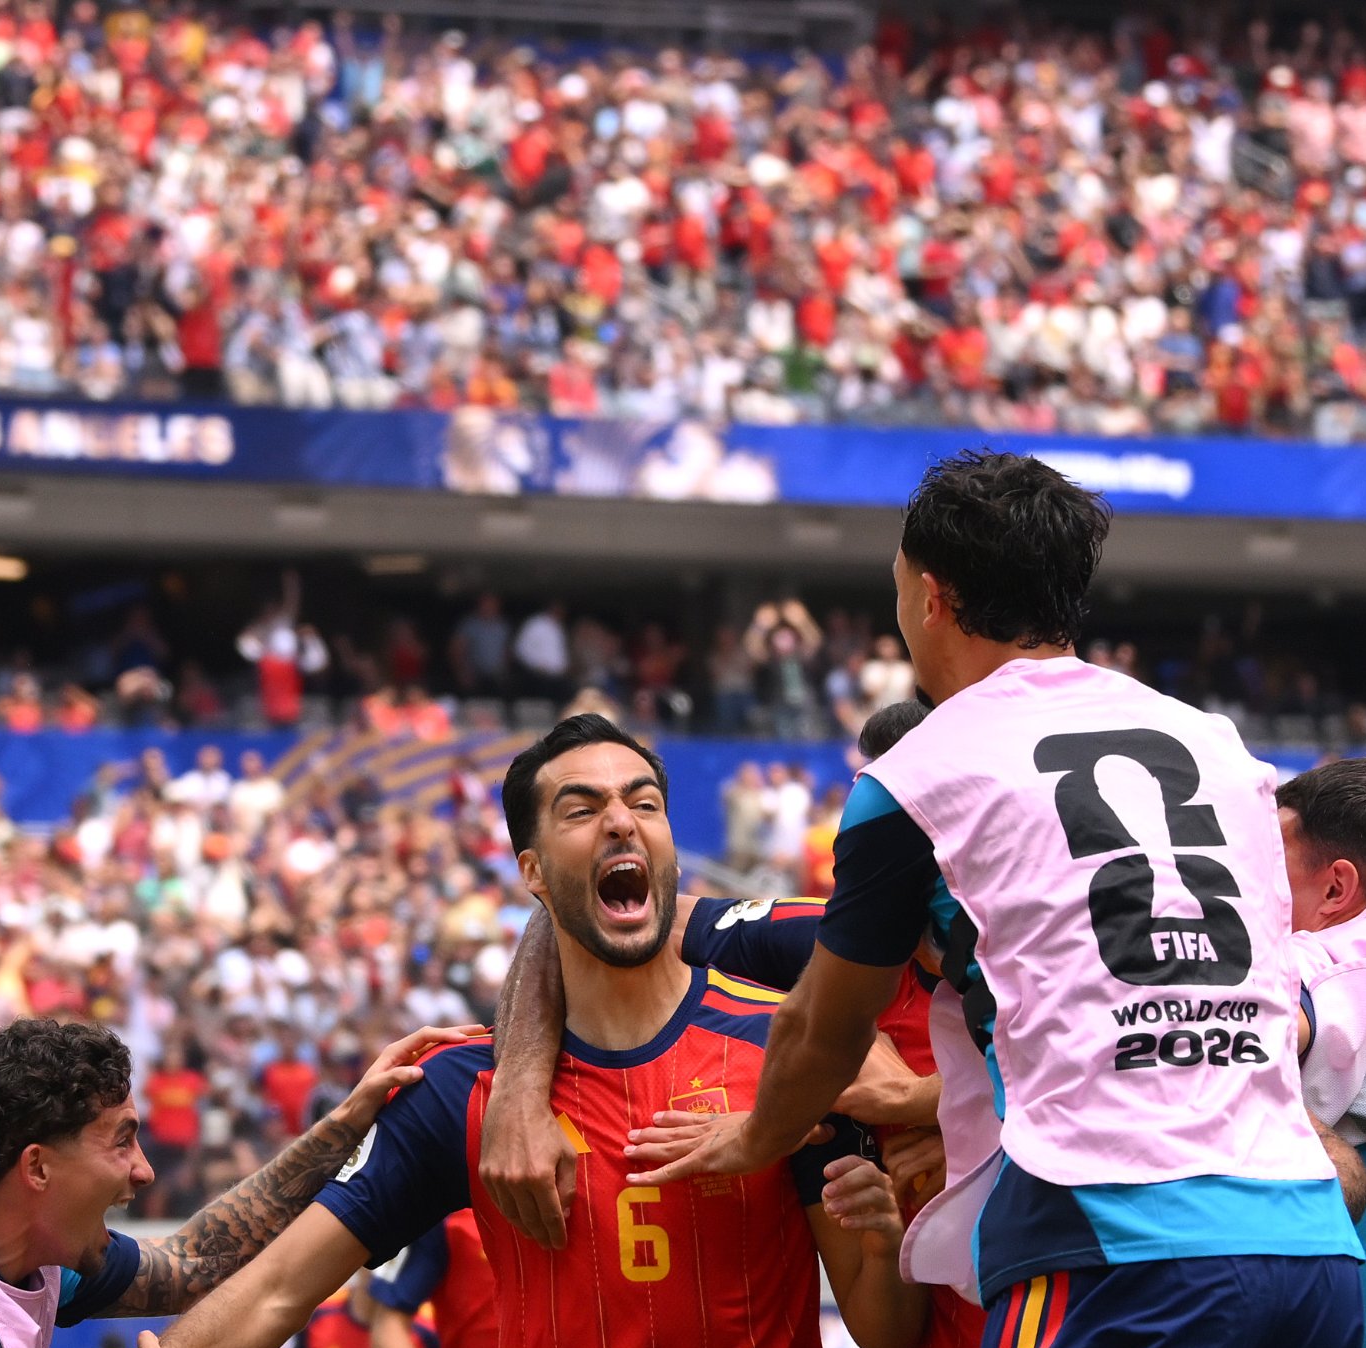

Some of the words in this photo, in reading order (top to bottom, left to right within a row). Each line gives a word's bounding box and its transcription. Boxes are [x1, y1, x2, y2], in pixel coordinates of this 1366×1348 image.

[7, 409, 233, 466] ANGELES
[1150, 931, 1218, 962] FIFA
[1111, 1000, 1213, 1026] WORLD
[1214, 1000, 1259, 1023] CUP
[1115, 1028, 1269, 1071] 2026
[616, 1187, 670, 1283] 6
